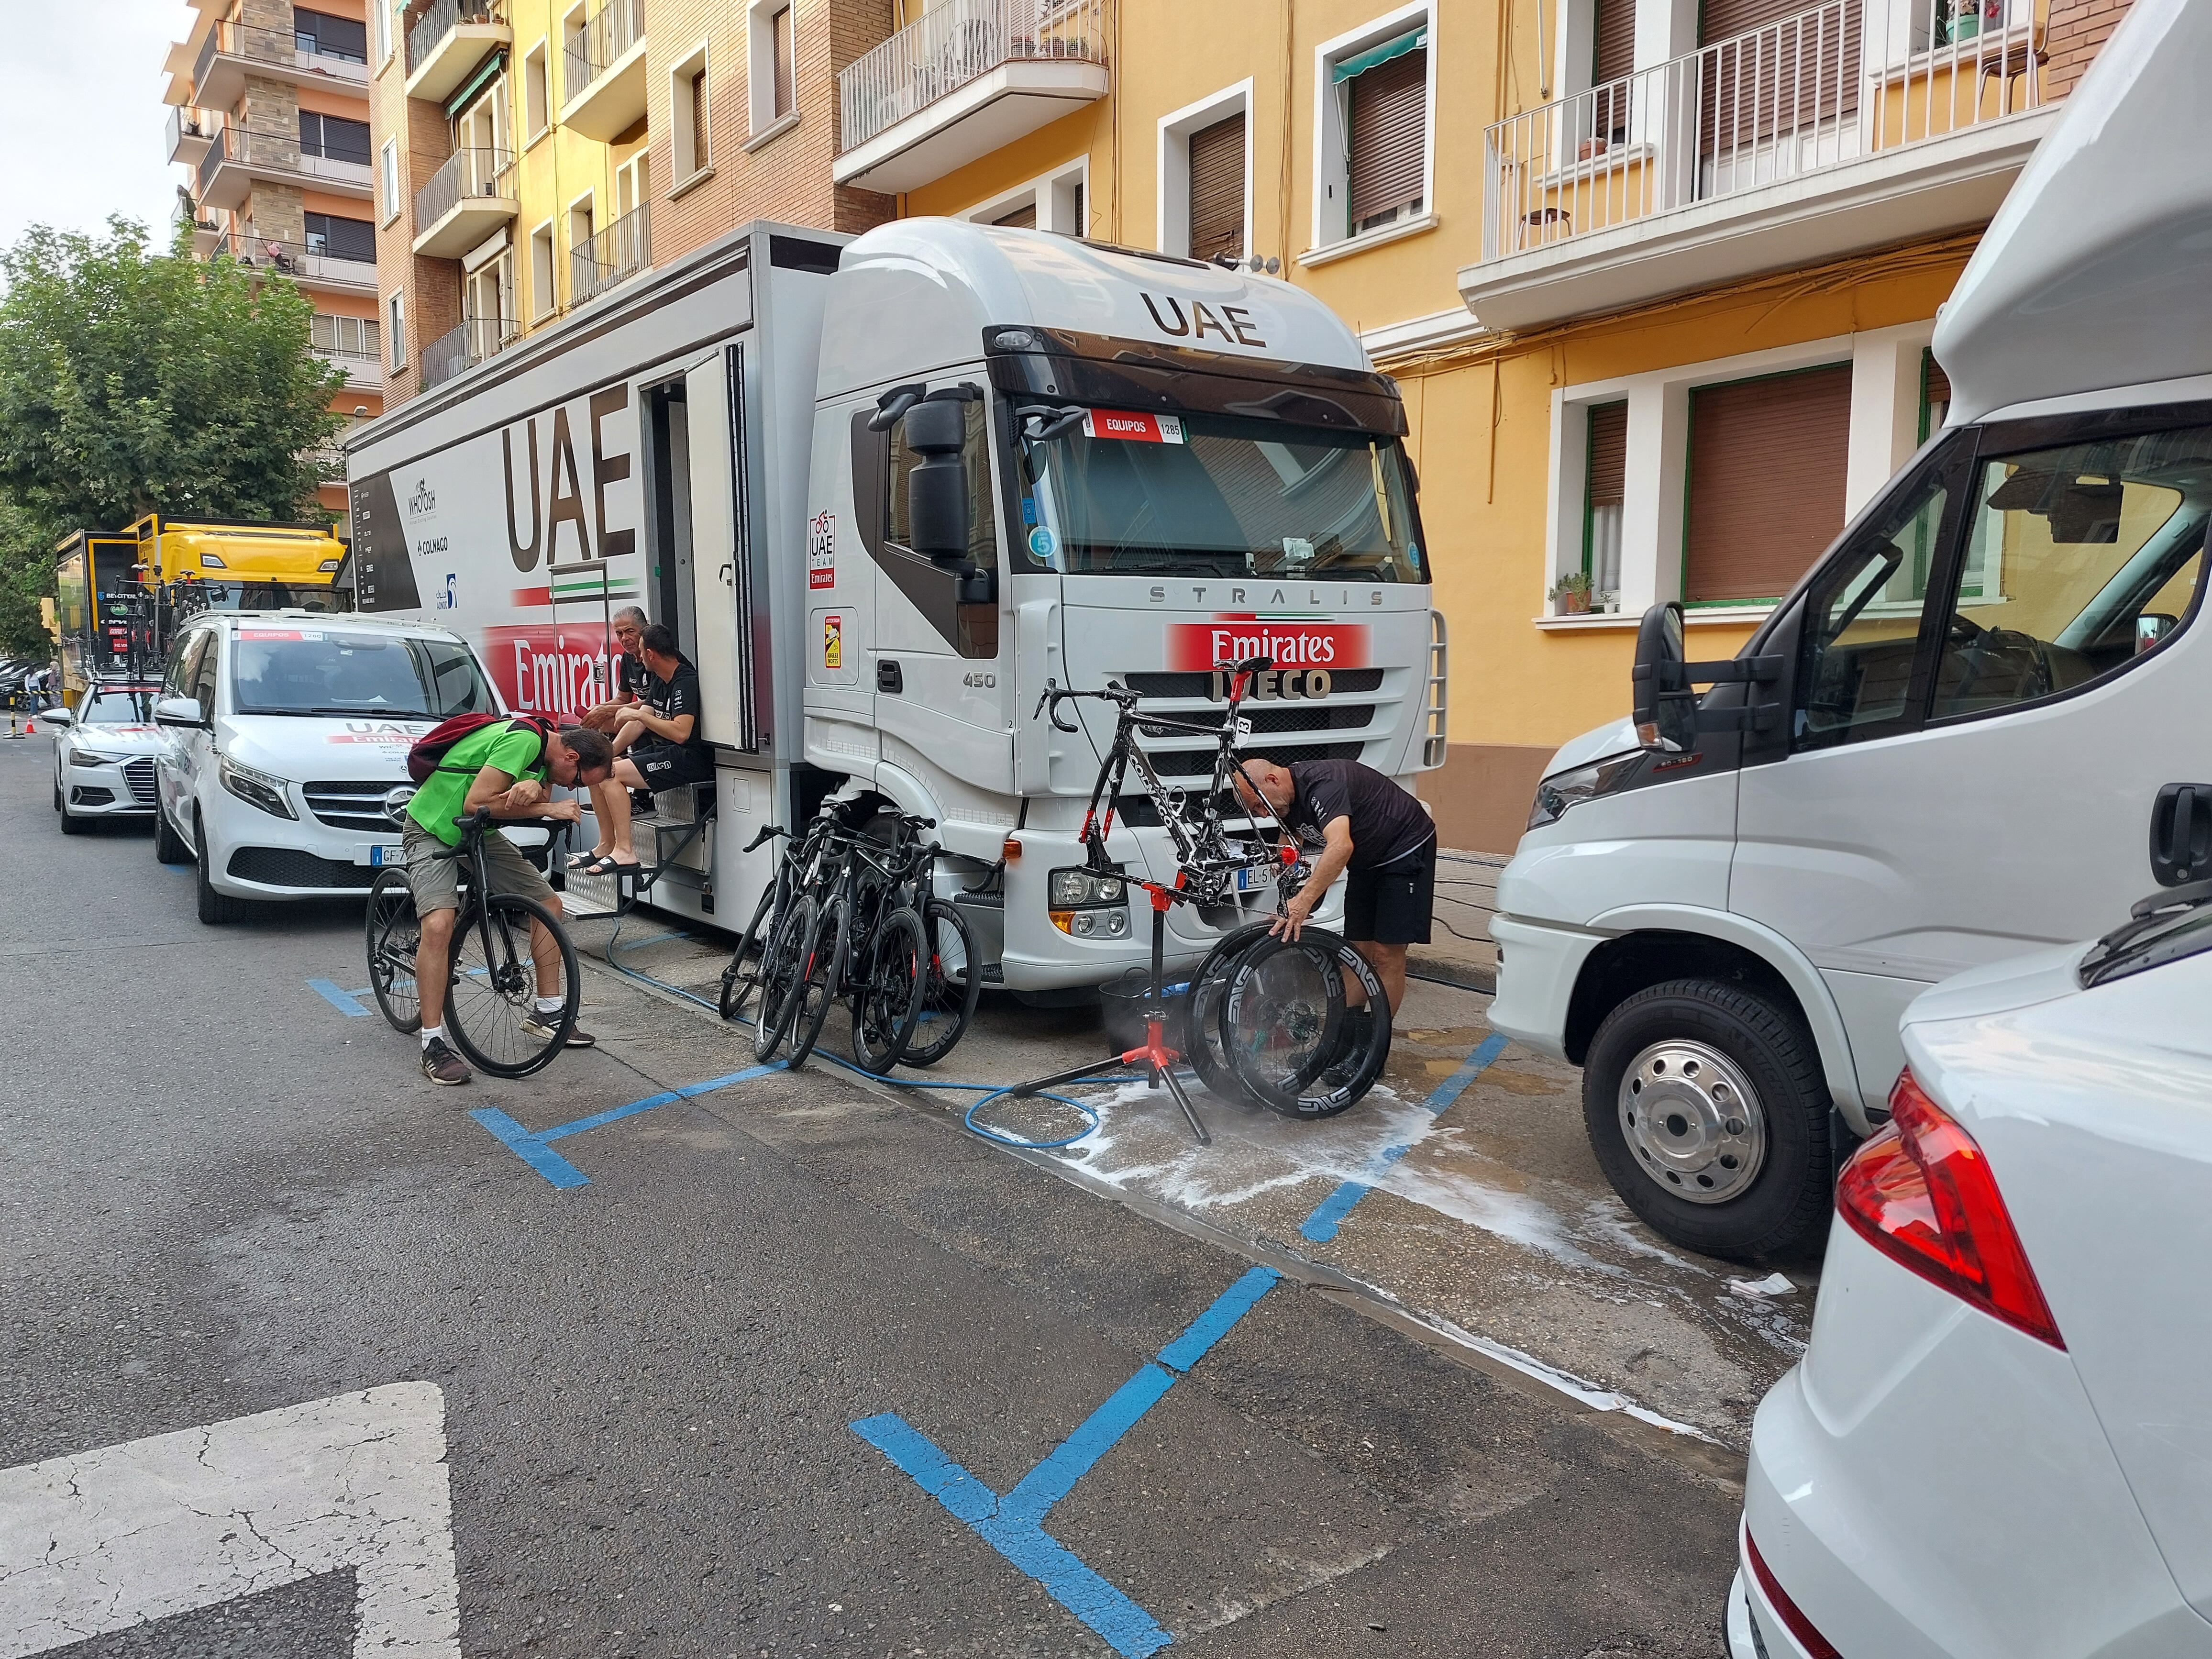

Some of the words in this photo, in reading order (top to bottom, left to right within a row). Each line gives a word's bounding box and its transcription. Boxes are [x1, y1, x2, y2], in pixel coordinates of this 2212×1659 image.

[1139, 292, 1267, 348] UAE
[1106, 419, 1146, 432] EQUIPOS
[1161, 424, 1180, 435] 1285
[502, 382, 636, 573] UAE
[422, 536, 448, 555] COLNAGO
[812, 535, 833, 556] UAE
[812, 557, 833, 567] TEAM
[811, 572, 833, 584] Emirates
[1150, 586, 1383, 605] STRALIS
[1211, 628, 1335, 663] Emirates
[963, 671, 995, 688] 450
[345, 723, 427, 735] UAE
[1008, 720, 1013, 728] 2
[1239, 721, 1250, 735] 13
